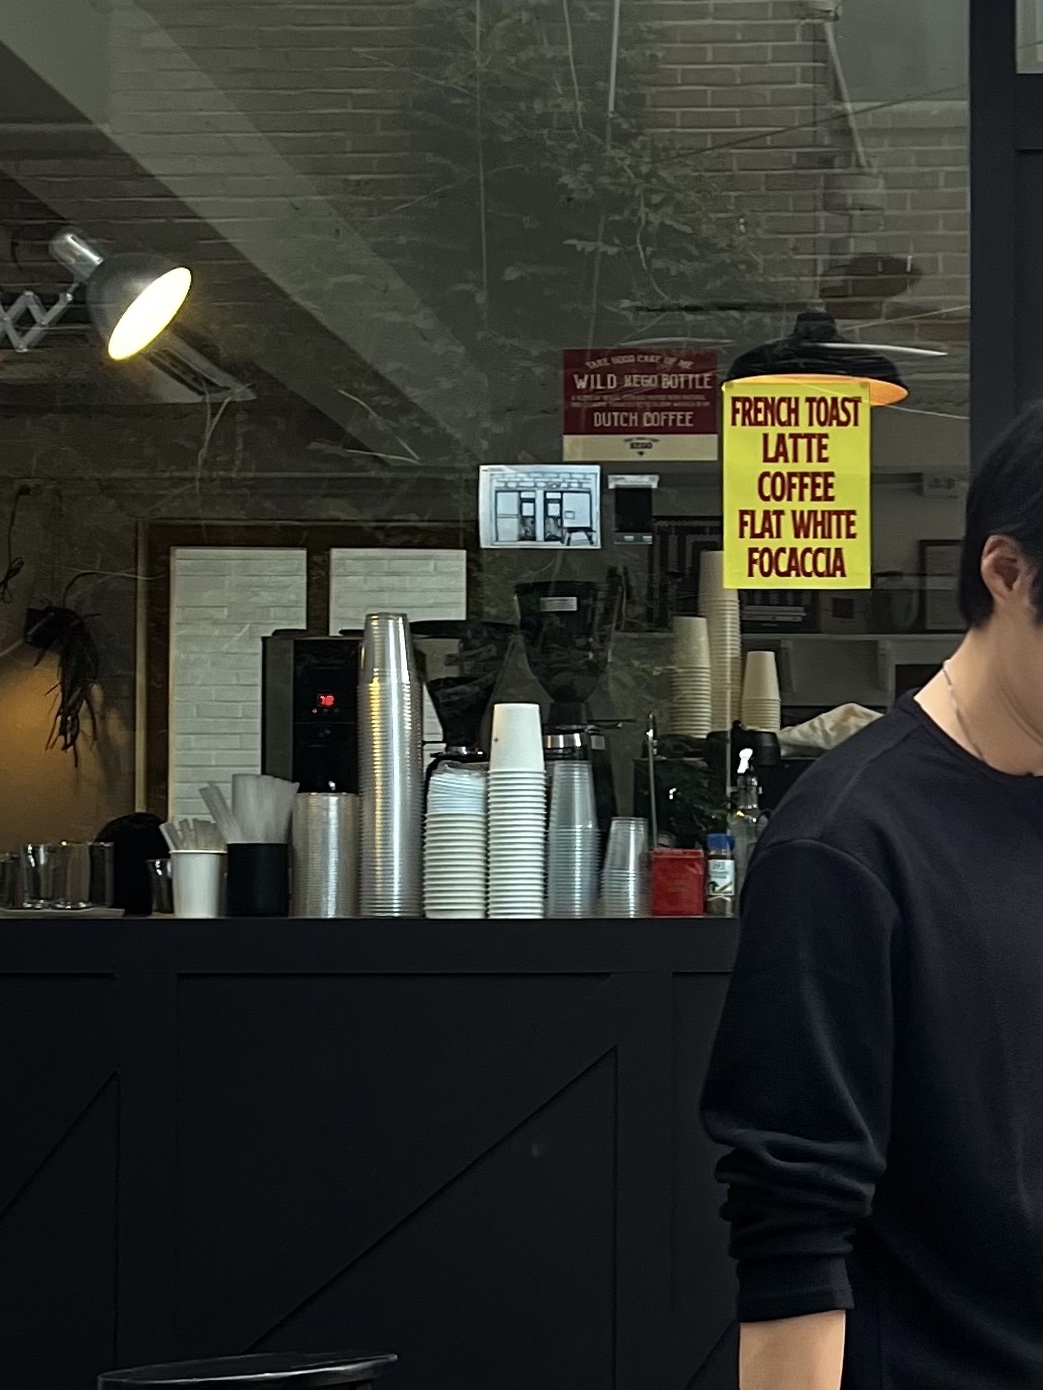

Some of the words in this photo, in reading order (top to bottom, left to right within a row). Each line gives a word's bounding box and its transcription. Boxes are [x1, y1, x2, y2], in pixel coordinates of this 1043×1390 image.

[573, 373, 617, 390] WILD
[661, 373, 713, 389] BOTTLE
[593, 411, 638, 427] DUTCH
[643, 411, 694, 427] COFFEE
[731, 396, 800, 427] FRENCH
[805, 396, 862, 427] TOAST
[762, 433, 829, 463] LATTE
[757, 471, 835, 502] COFFEE
[738, 509, 785, 539] FLAT
[791, 509, 857, 539] WHITE
[747, 546, 847, 577] FOCACCIA
